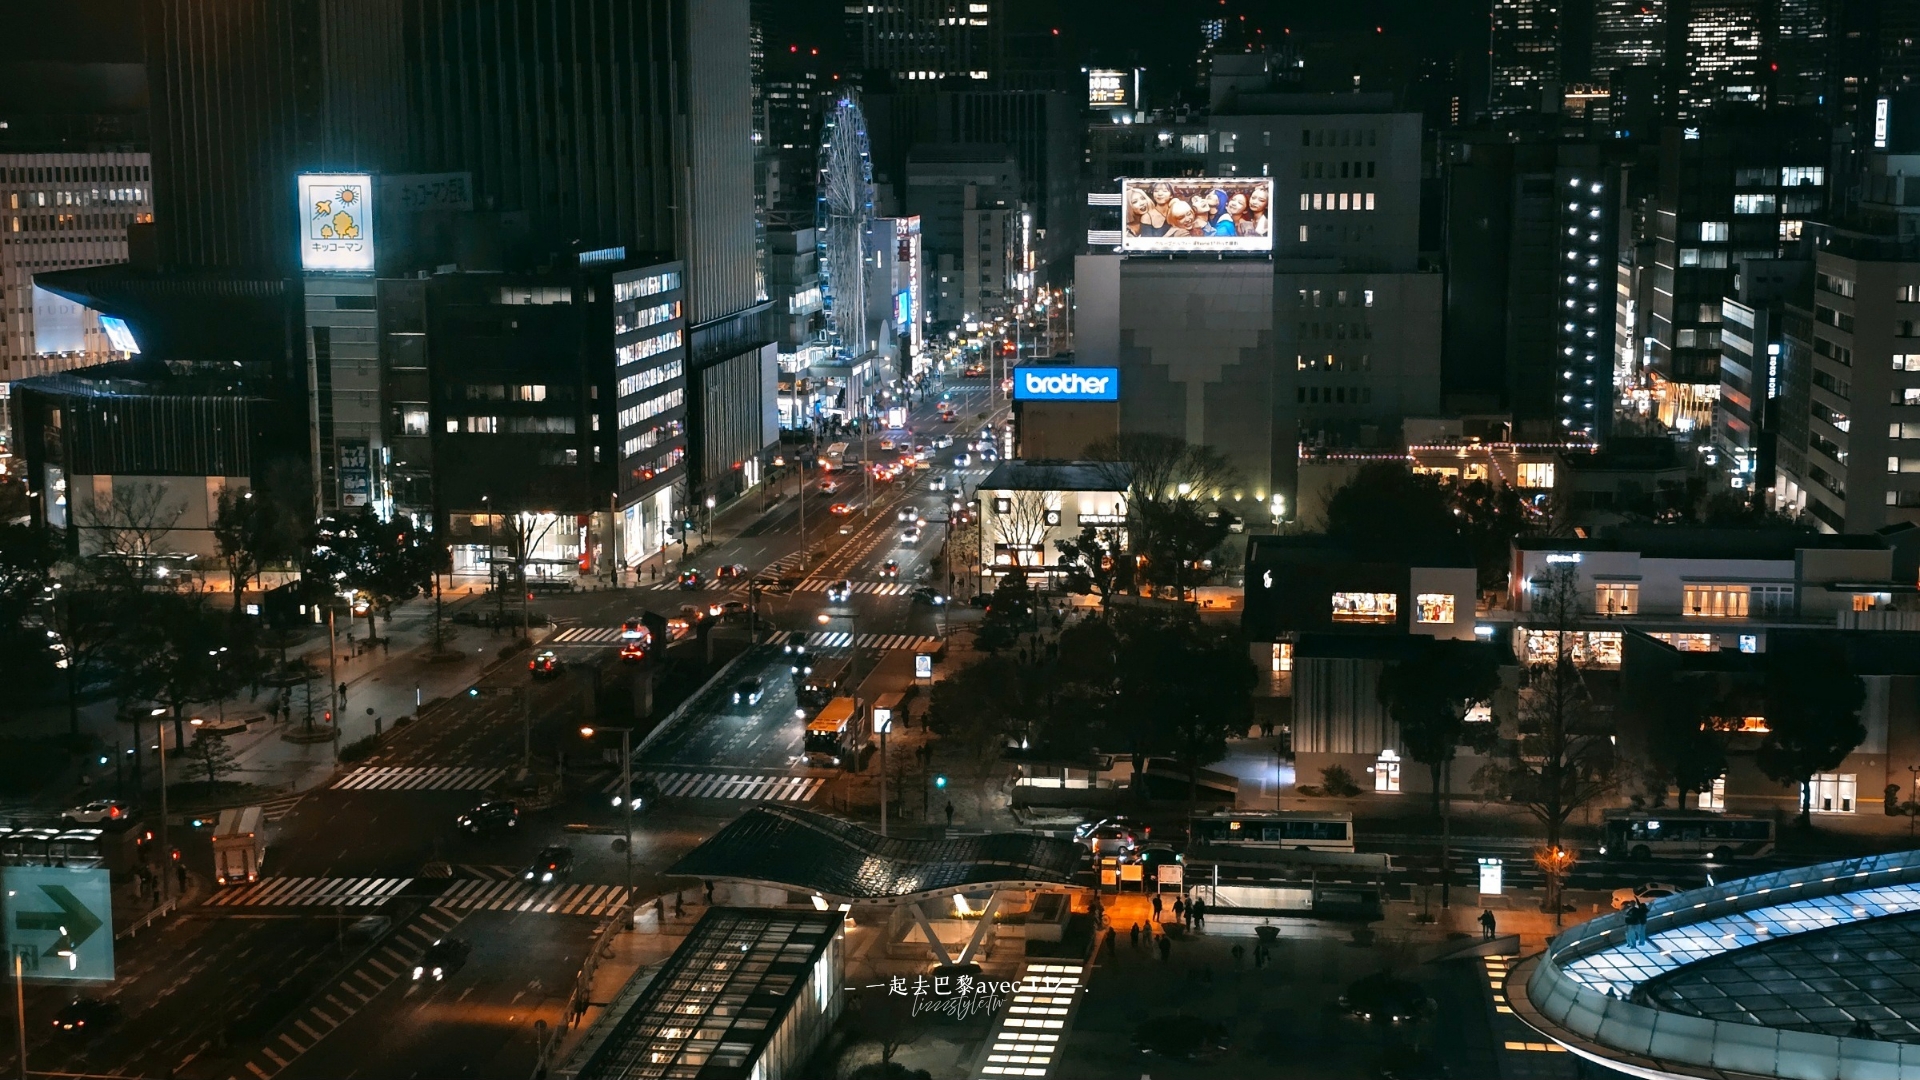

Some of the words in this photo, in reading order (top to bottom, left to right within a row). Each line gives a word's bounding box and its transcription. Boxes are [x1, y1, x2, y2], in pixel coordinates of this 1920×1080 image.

[311, 242, 363, 252] キッコーマン
[1025, 372, 1110, 394] brother
